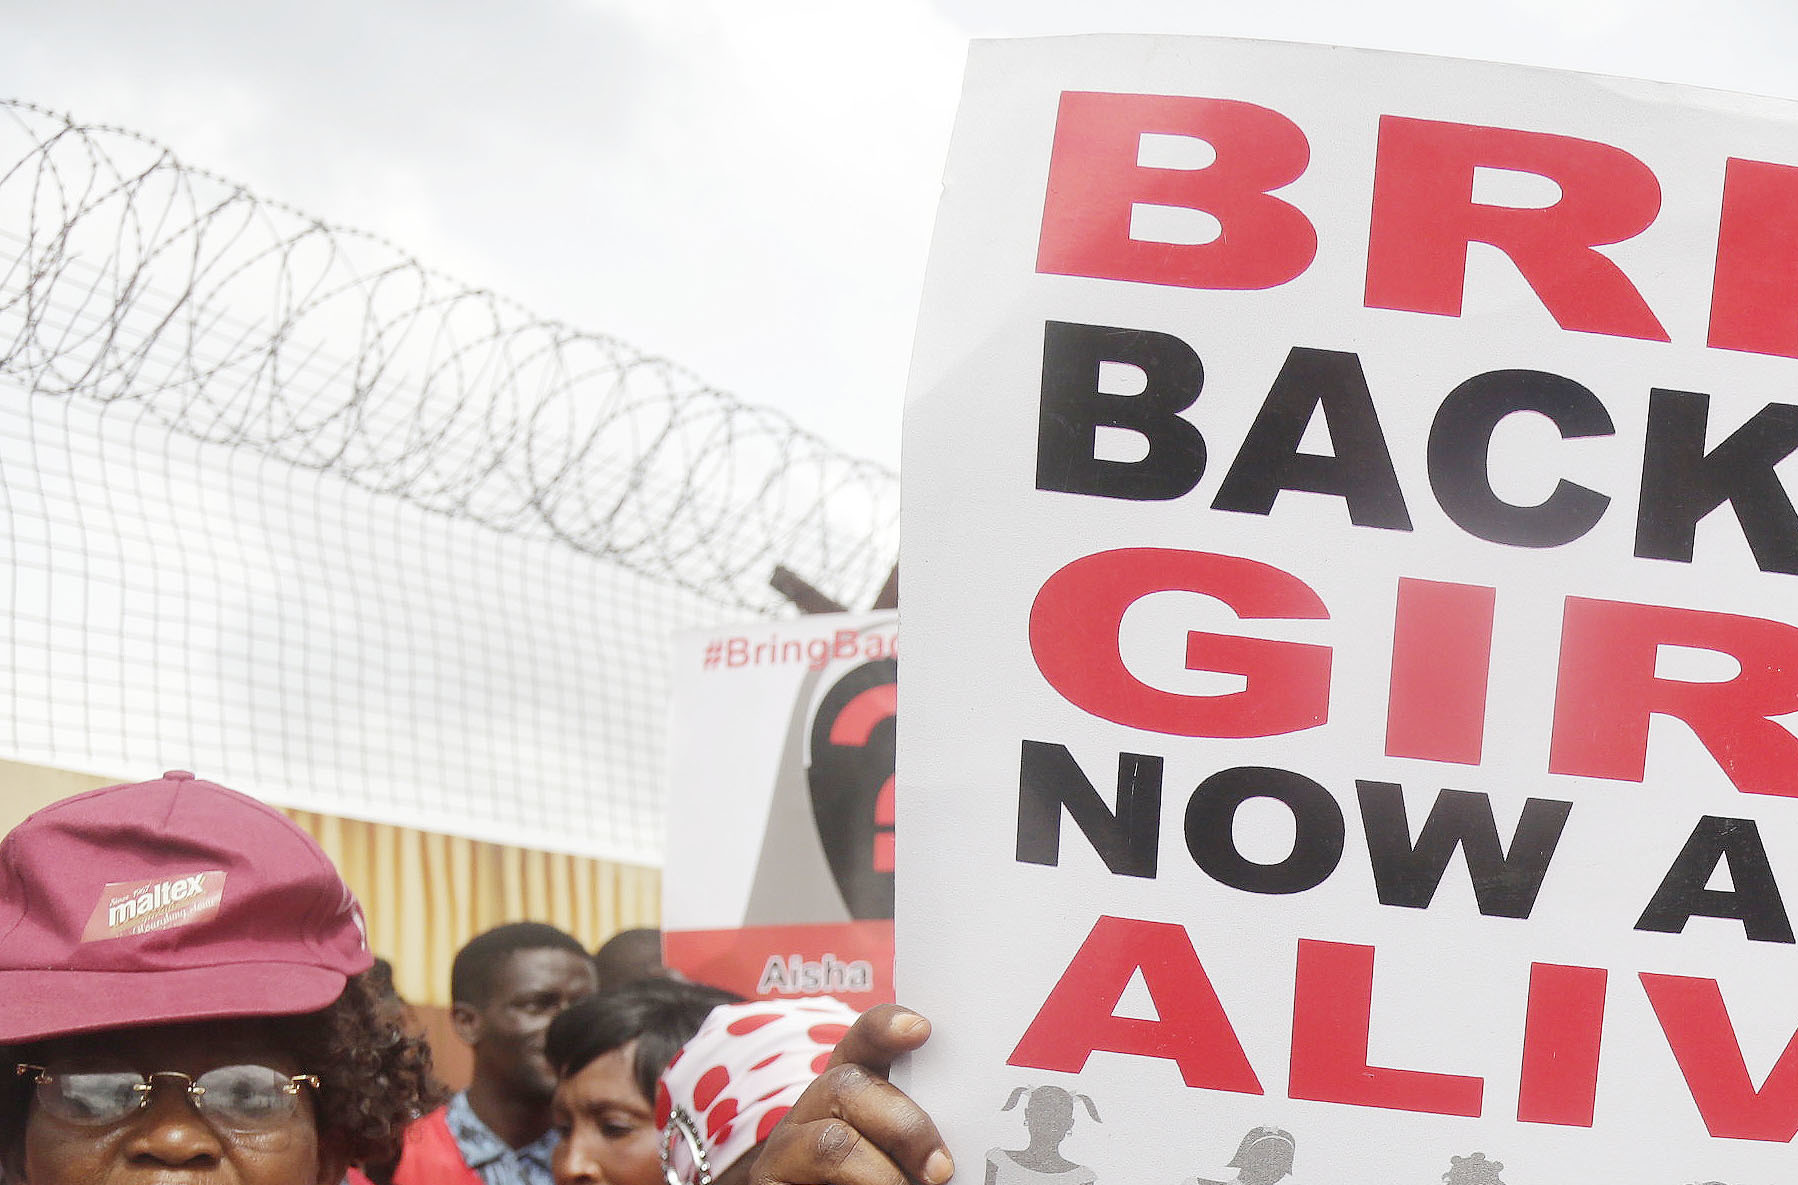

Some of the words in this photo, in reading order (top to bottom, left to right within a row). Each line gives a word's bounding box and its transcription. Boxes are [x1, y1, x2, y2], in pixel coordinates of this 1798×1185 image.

[1015, 740, 1574, 920] NOW
[108, 871, 206, 928] maltex
[757, 953, 873, 995] Aisha
